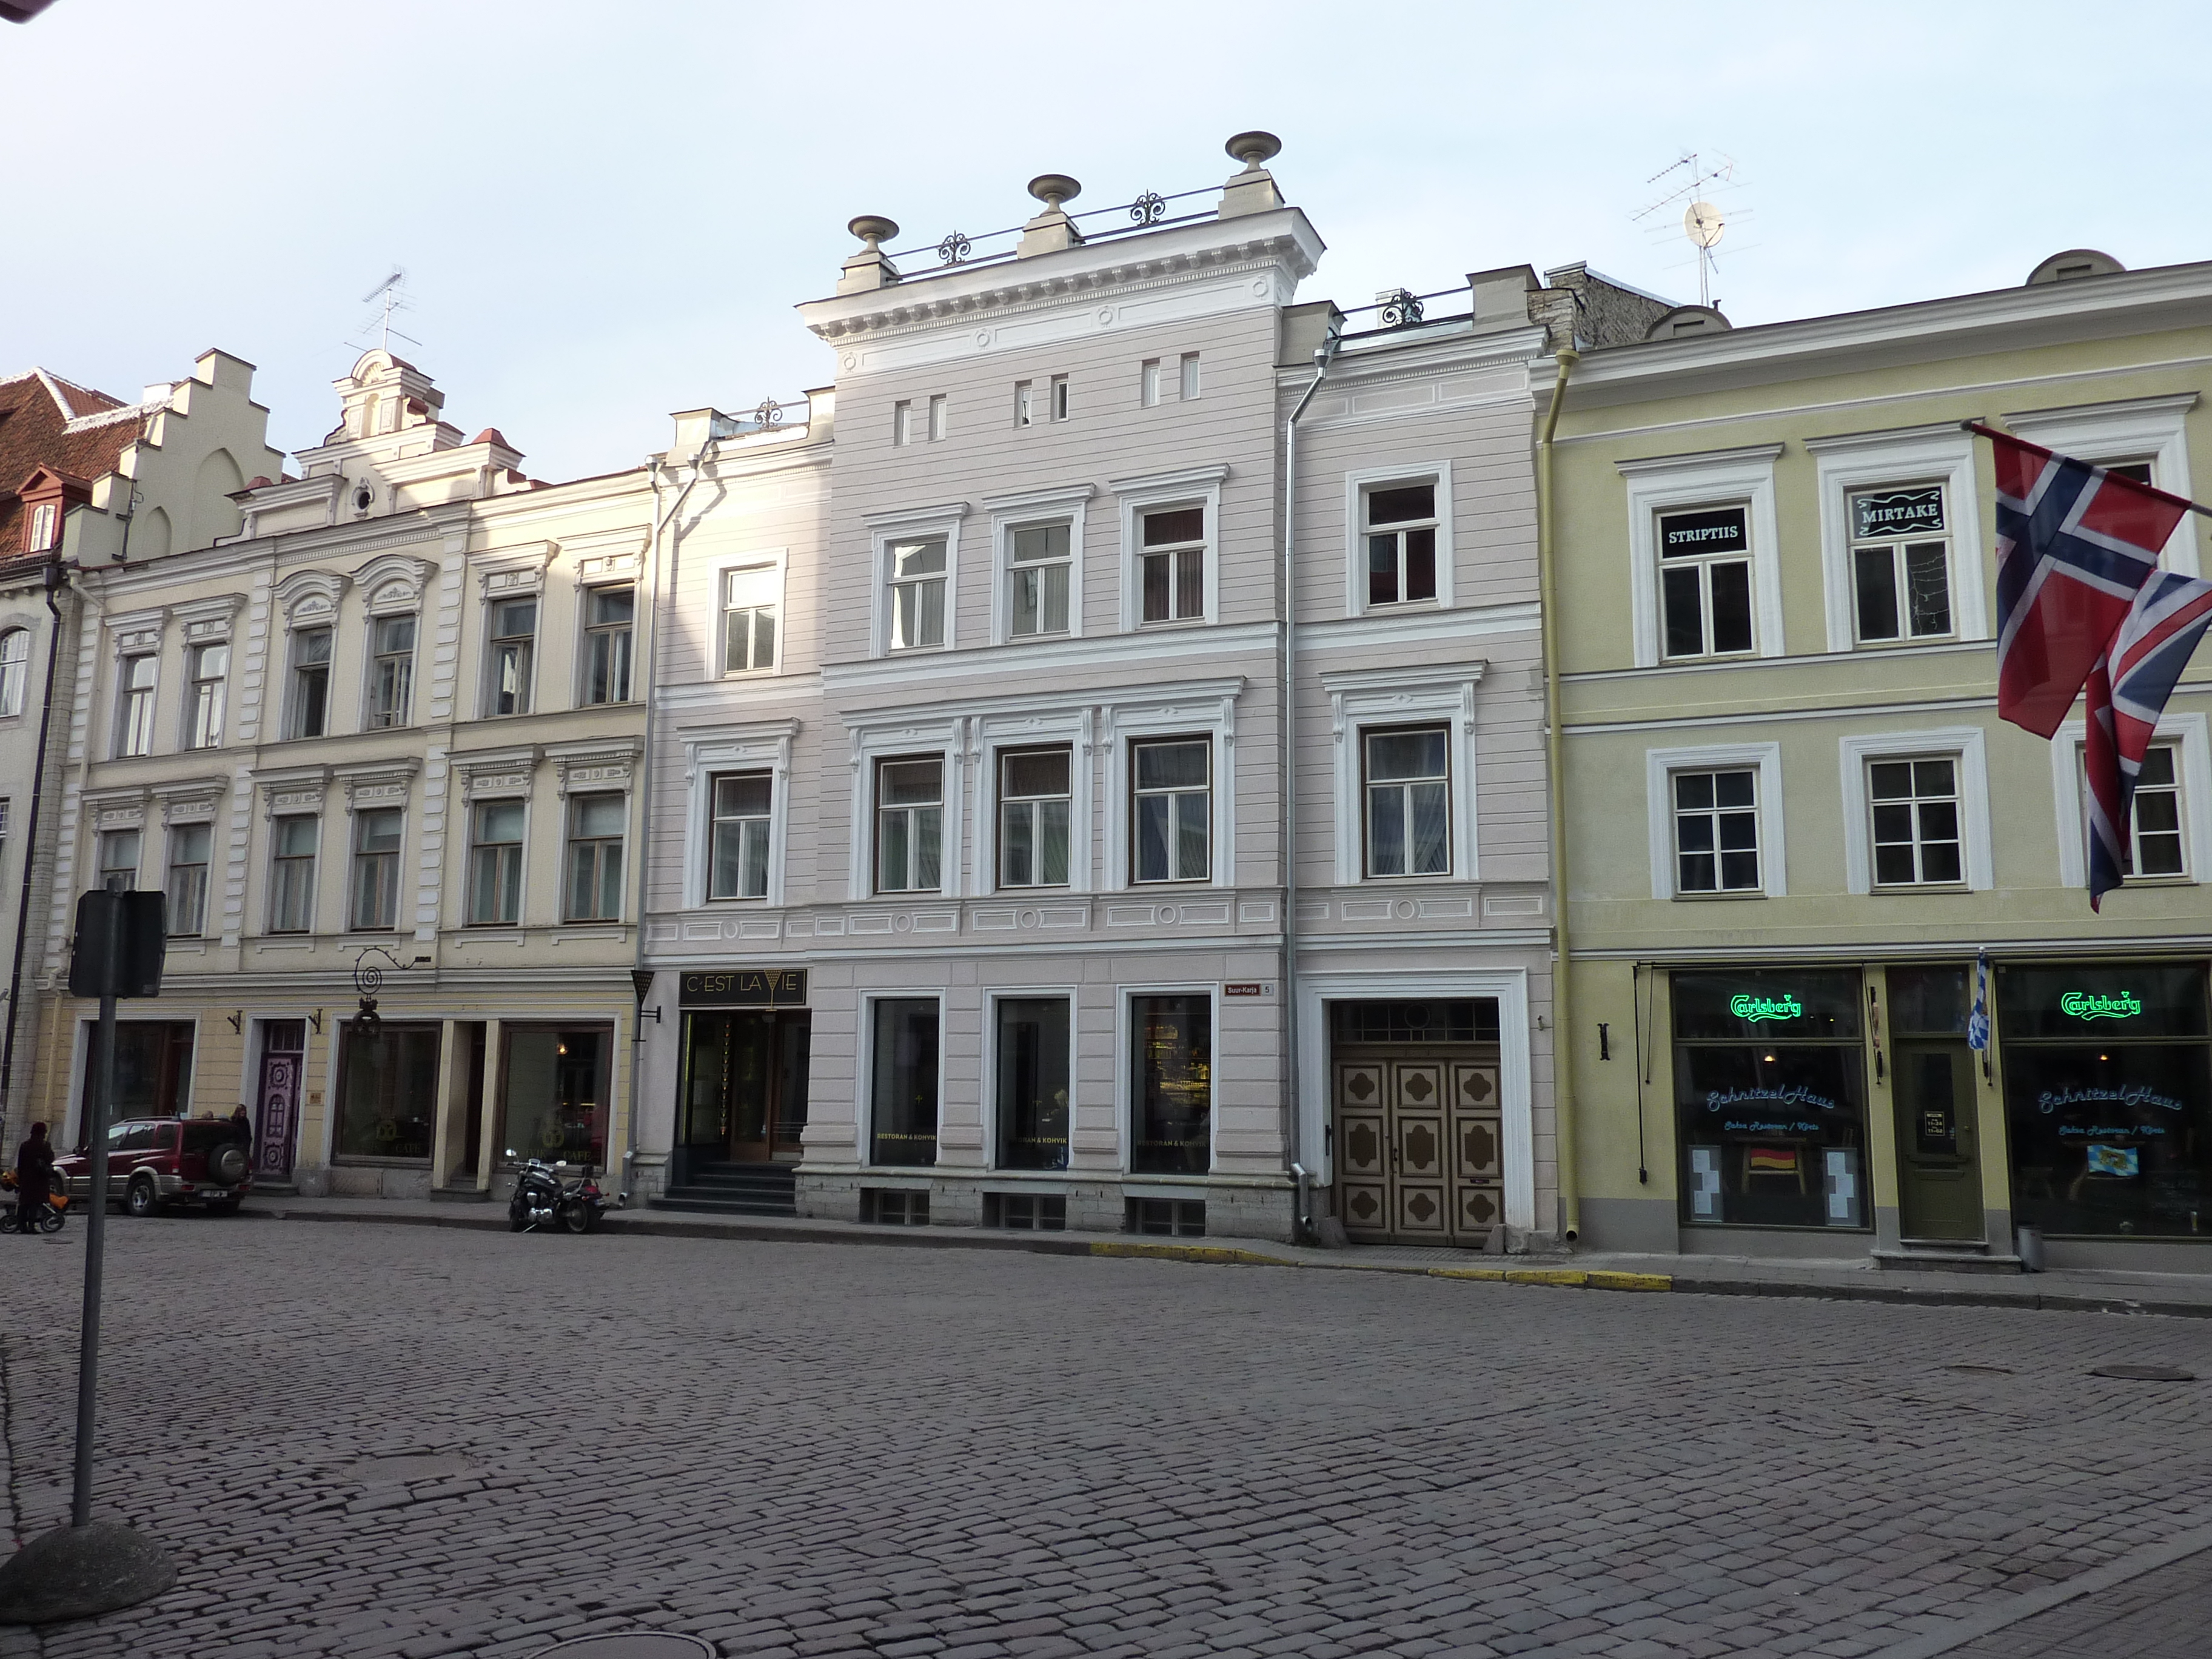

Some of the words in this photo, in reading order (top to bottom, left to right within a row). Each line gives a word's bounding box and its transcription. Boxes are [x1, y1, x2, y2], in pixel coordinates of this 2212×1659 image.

[1862, 504, 1938, 523] MIRTAKE
[1669, 526, 1738, 544] STRIPTIIS
[686, 976, 735, 991] C'EST
[740, 975, 762, 991] LA
[764, 970, 797, 994] VIE
[1731, 994, 1801, 1019] Carlsberg
[2061, 991, 2140, 1017] Carlsberg
